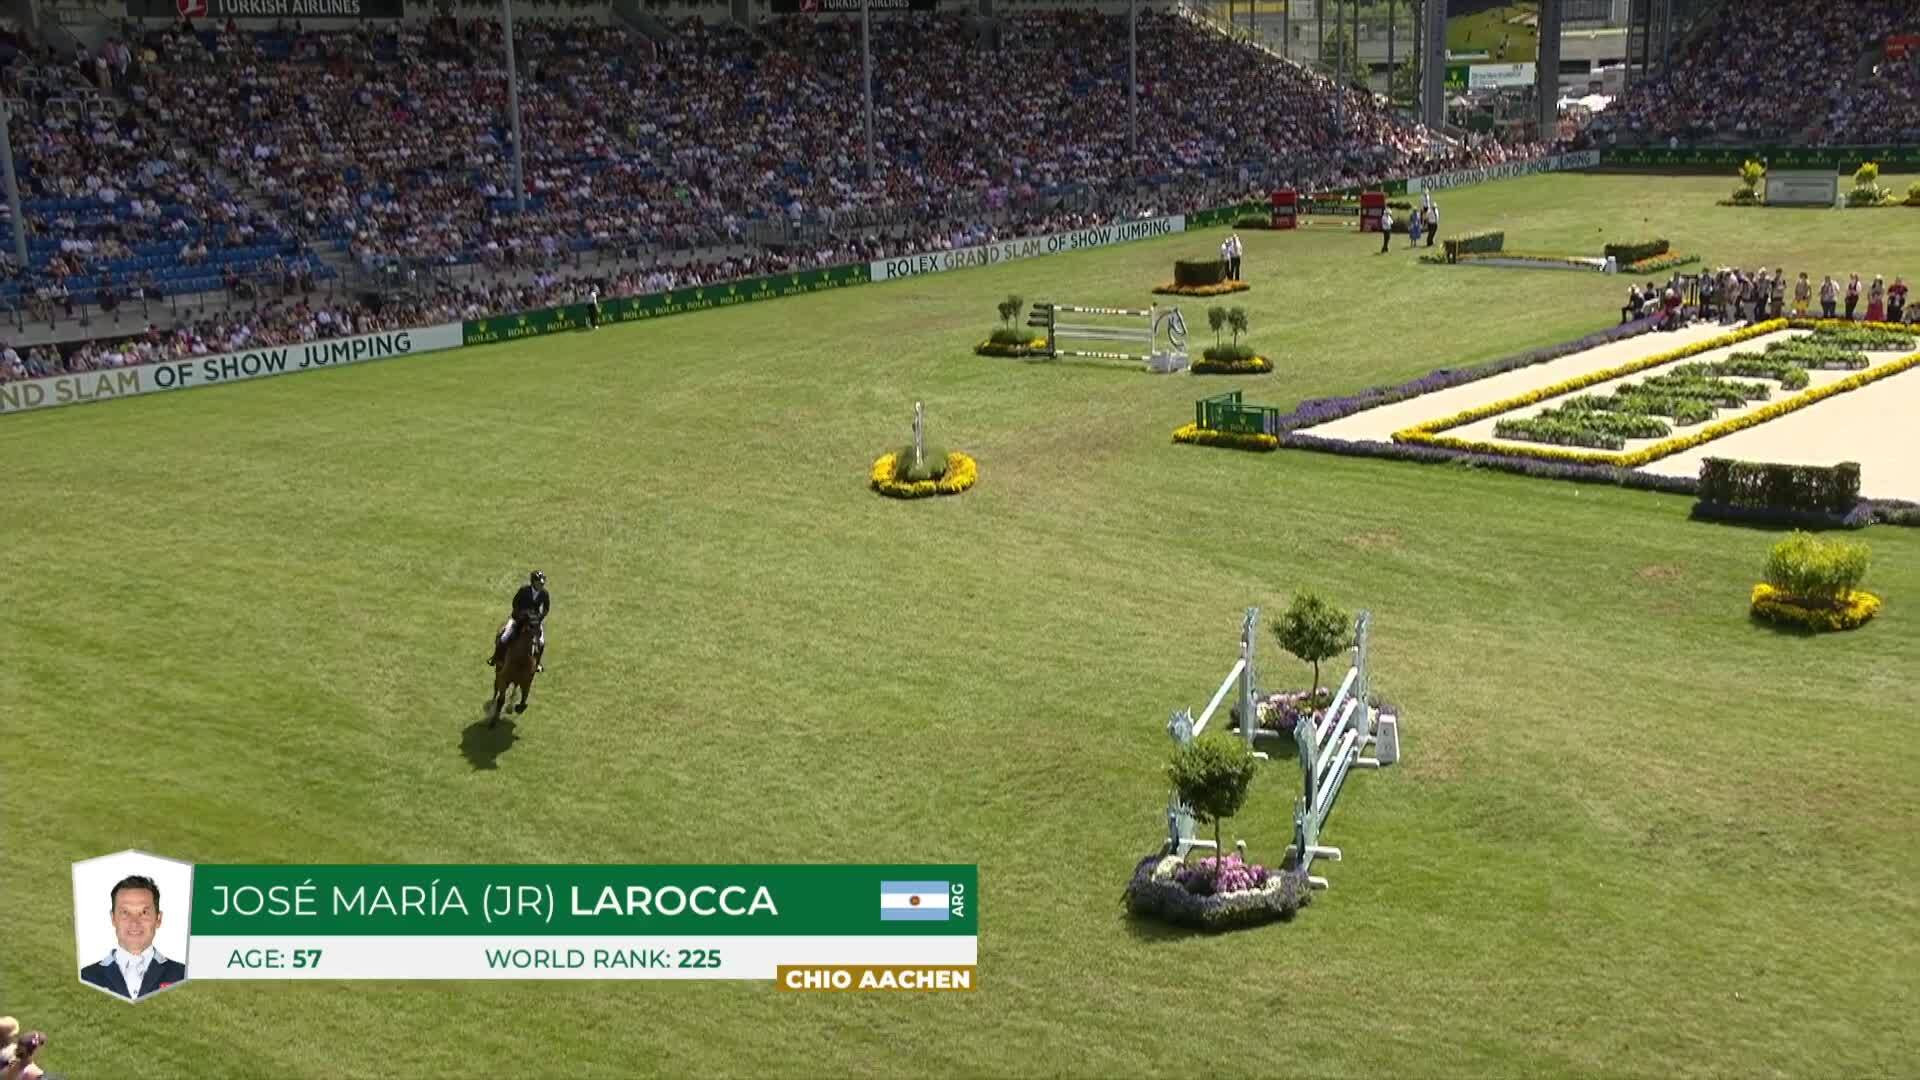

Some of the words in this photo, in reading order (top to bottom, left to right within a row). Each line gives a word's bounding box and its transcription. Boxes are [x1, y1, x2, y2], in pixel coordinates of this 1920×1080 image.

[218, 0, 288, 14] TURKISH
[291, 0, 361, 14] AIRLINES
[1420, 177, 1450, 193] ROLEX
[1453, 172, 1484, 187] GRAND
[887, 255, 940, 279] ROLEX
[944, 246, 1000, 270] GRAND
[1004, 239, 1041, 260] SLAM
[1048, 235, 1067, 251] OF
[1071, 228, 1112, 248] SHOW
[1116, 219, 1171, 241] JUMPING
[623, 309, 650, 320] ROLEX
[508, 325, 538, 338] ROLEX
[547, 320, 576, 331] ROLEX
[468, 332, 498, 344] ROLEX
[55, 369, 141, 402] SLAM
[154, 362, 193, 388] OF
[204, 348, 288, 381] SHOW
[299, 331, 411, 367] JUMPING
